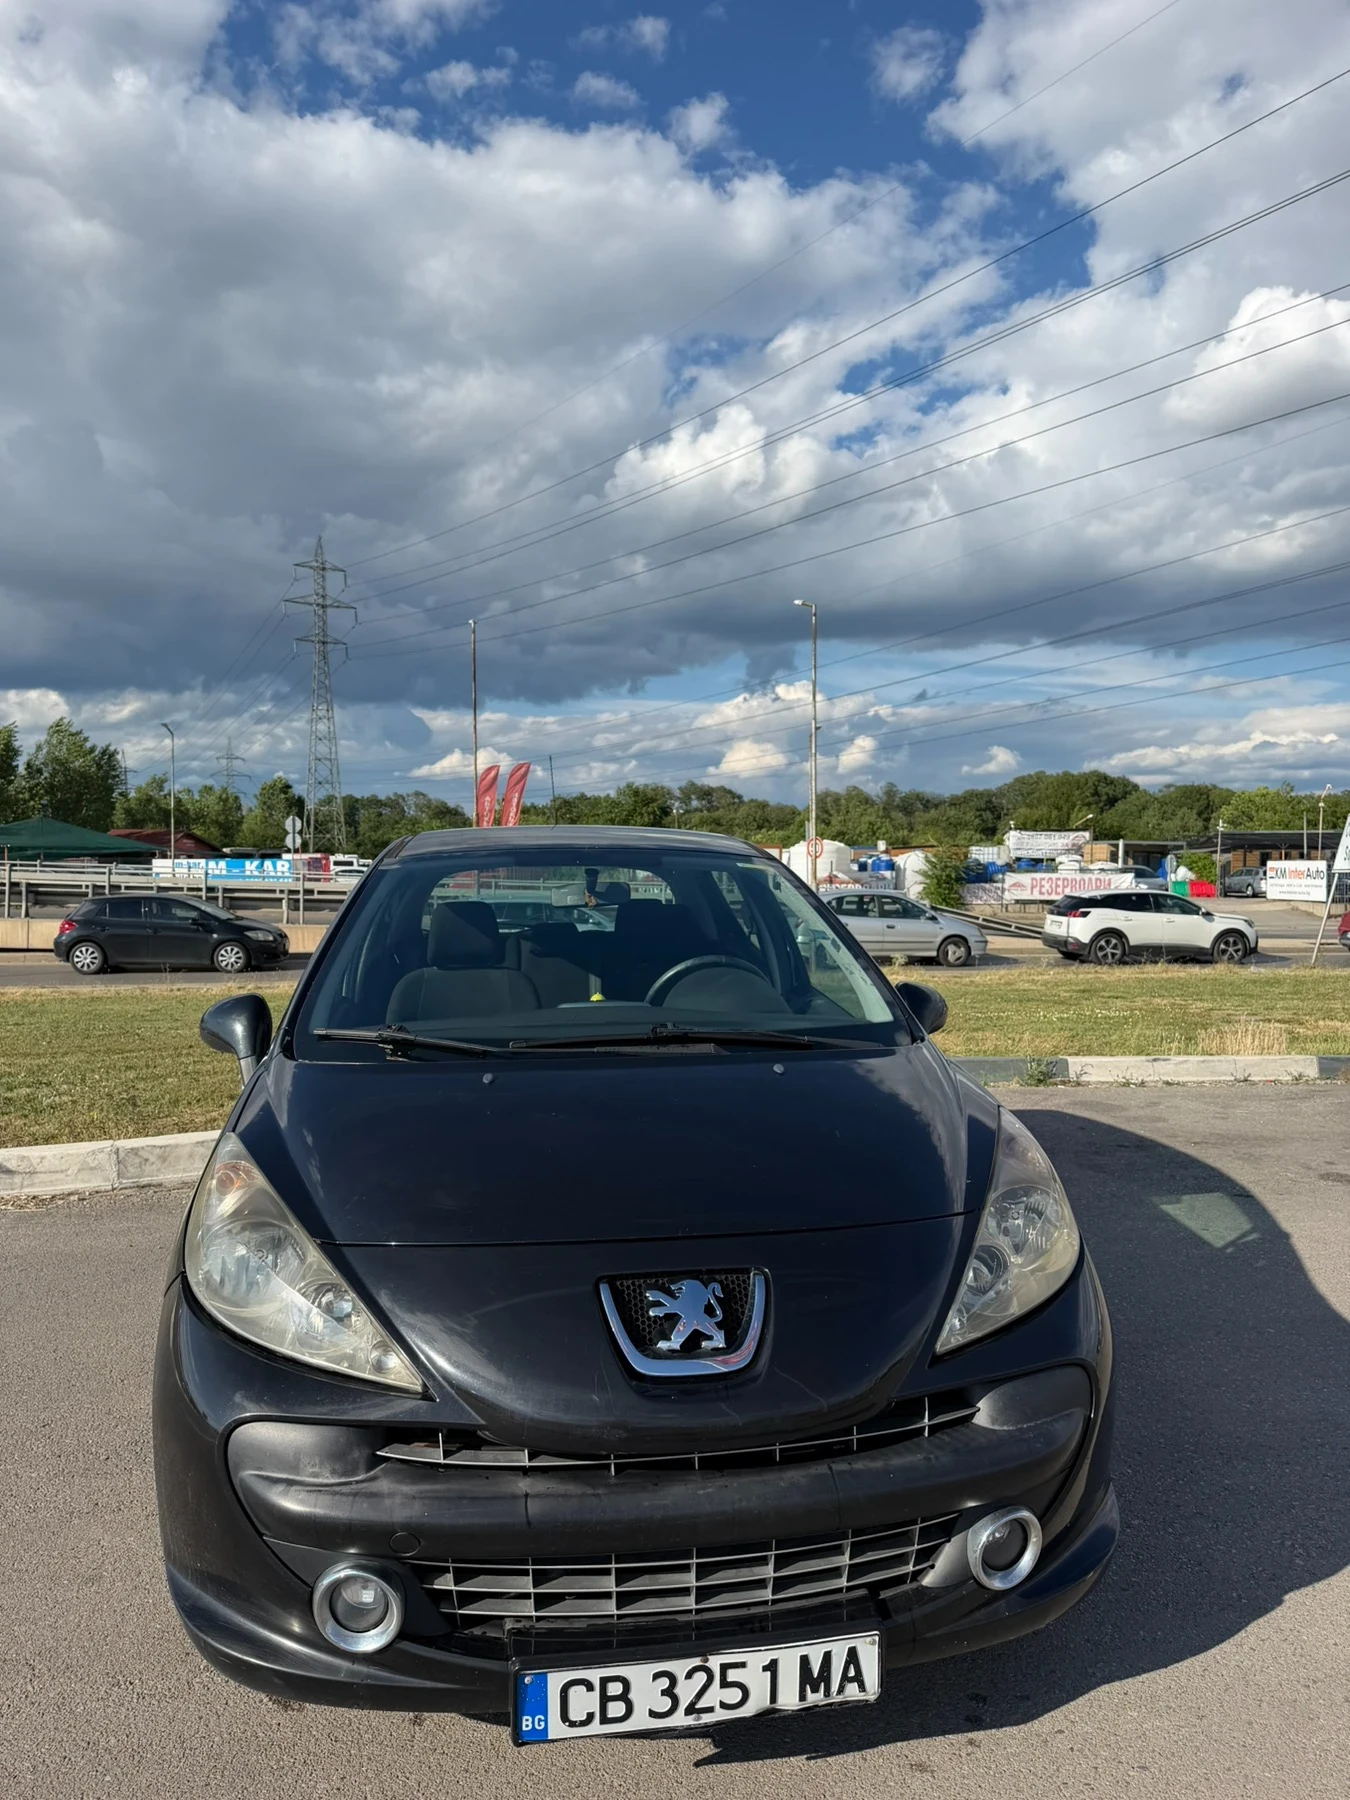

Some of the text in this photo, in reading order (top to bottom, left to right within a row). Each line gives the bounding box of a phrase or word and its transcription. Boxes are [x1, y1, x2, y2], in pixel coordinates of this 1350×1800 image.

[559, 1645, 867, 1728] CB 3251 MA
[521, 1714, 545, 1732] BG
